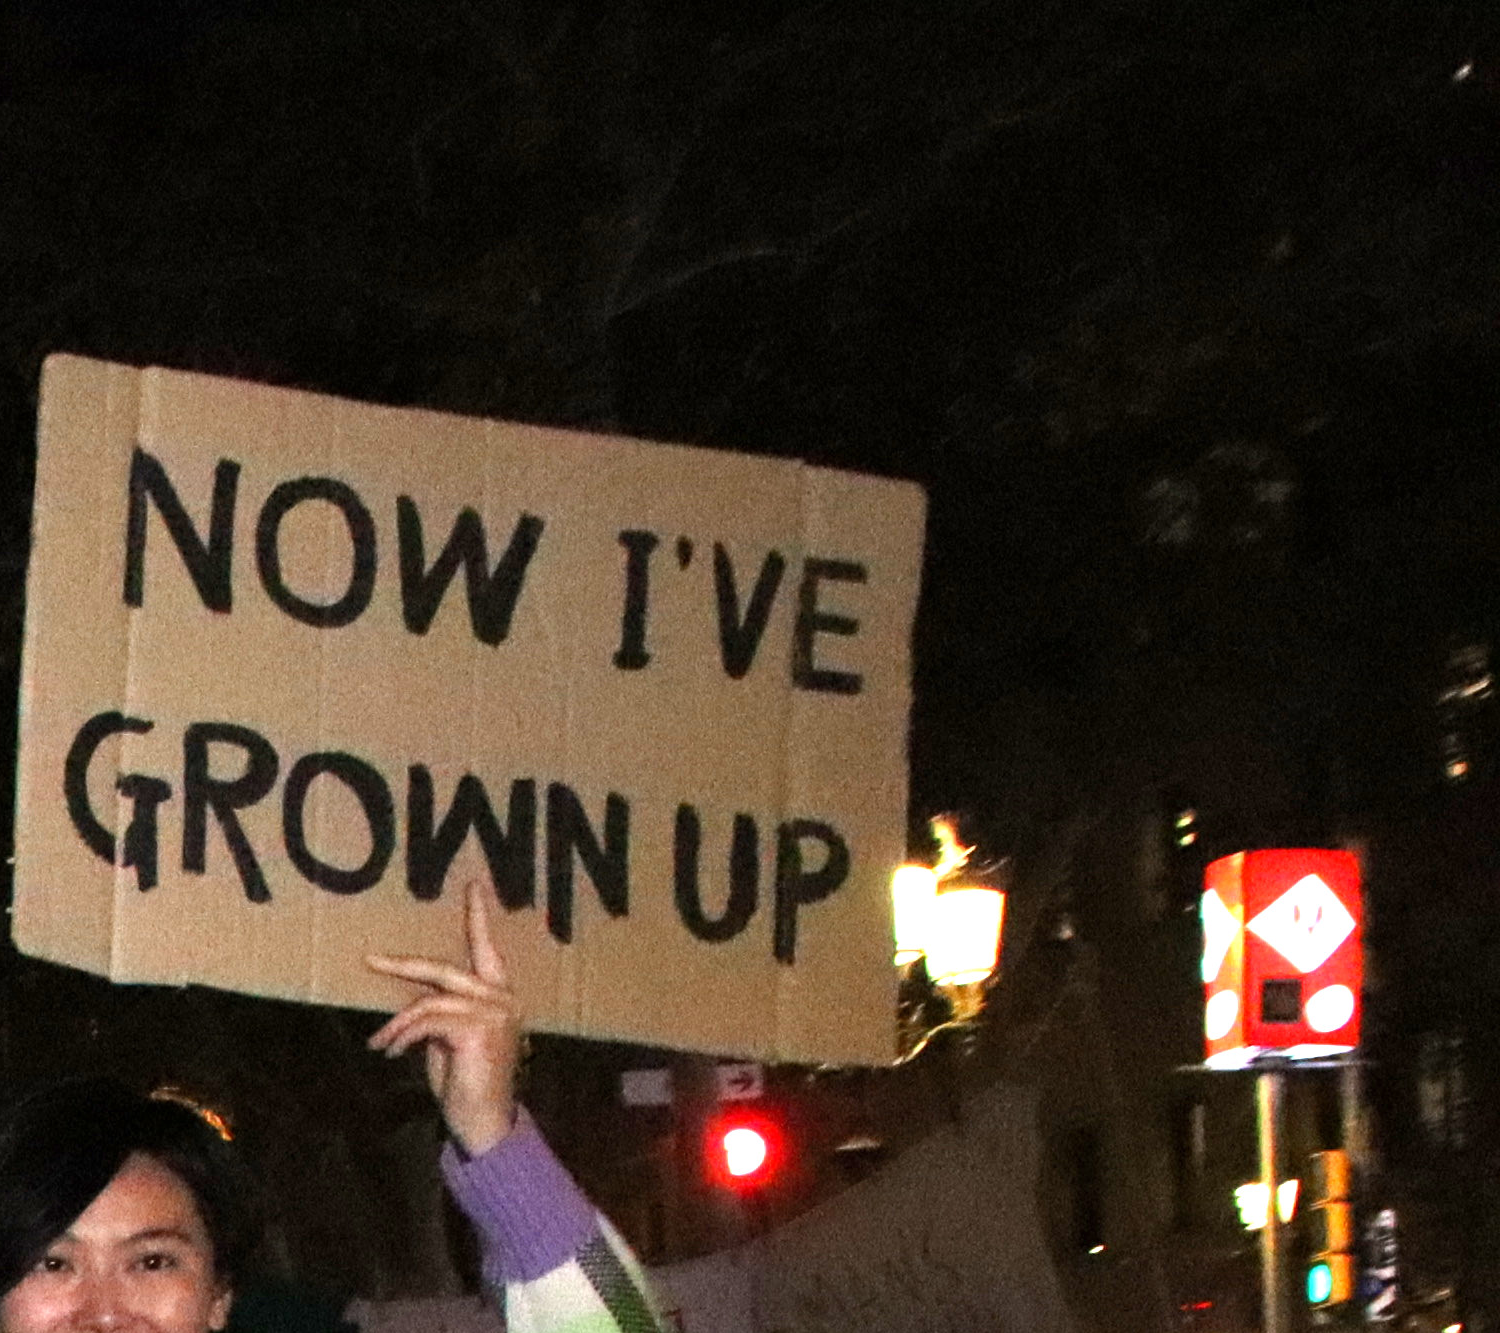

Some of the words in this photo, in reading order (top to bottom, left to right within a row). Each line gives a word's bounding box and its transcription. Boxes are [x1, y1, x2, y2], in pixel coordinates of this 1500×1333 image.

[122, 443, 545, 649] NOW
[613, 529, 868, 696] I'VE
[63, 710, 631, 945] GROWN
[673, 802, 851, 967] UP
